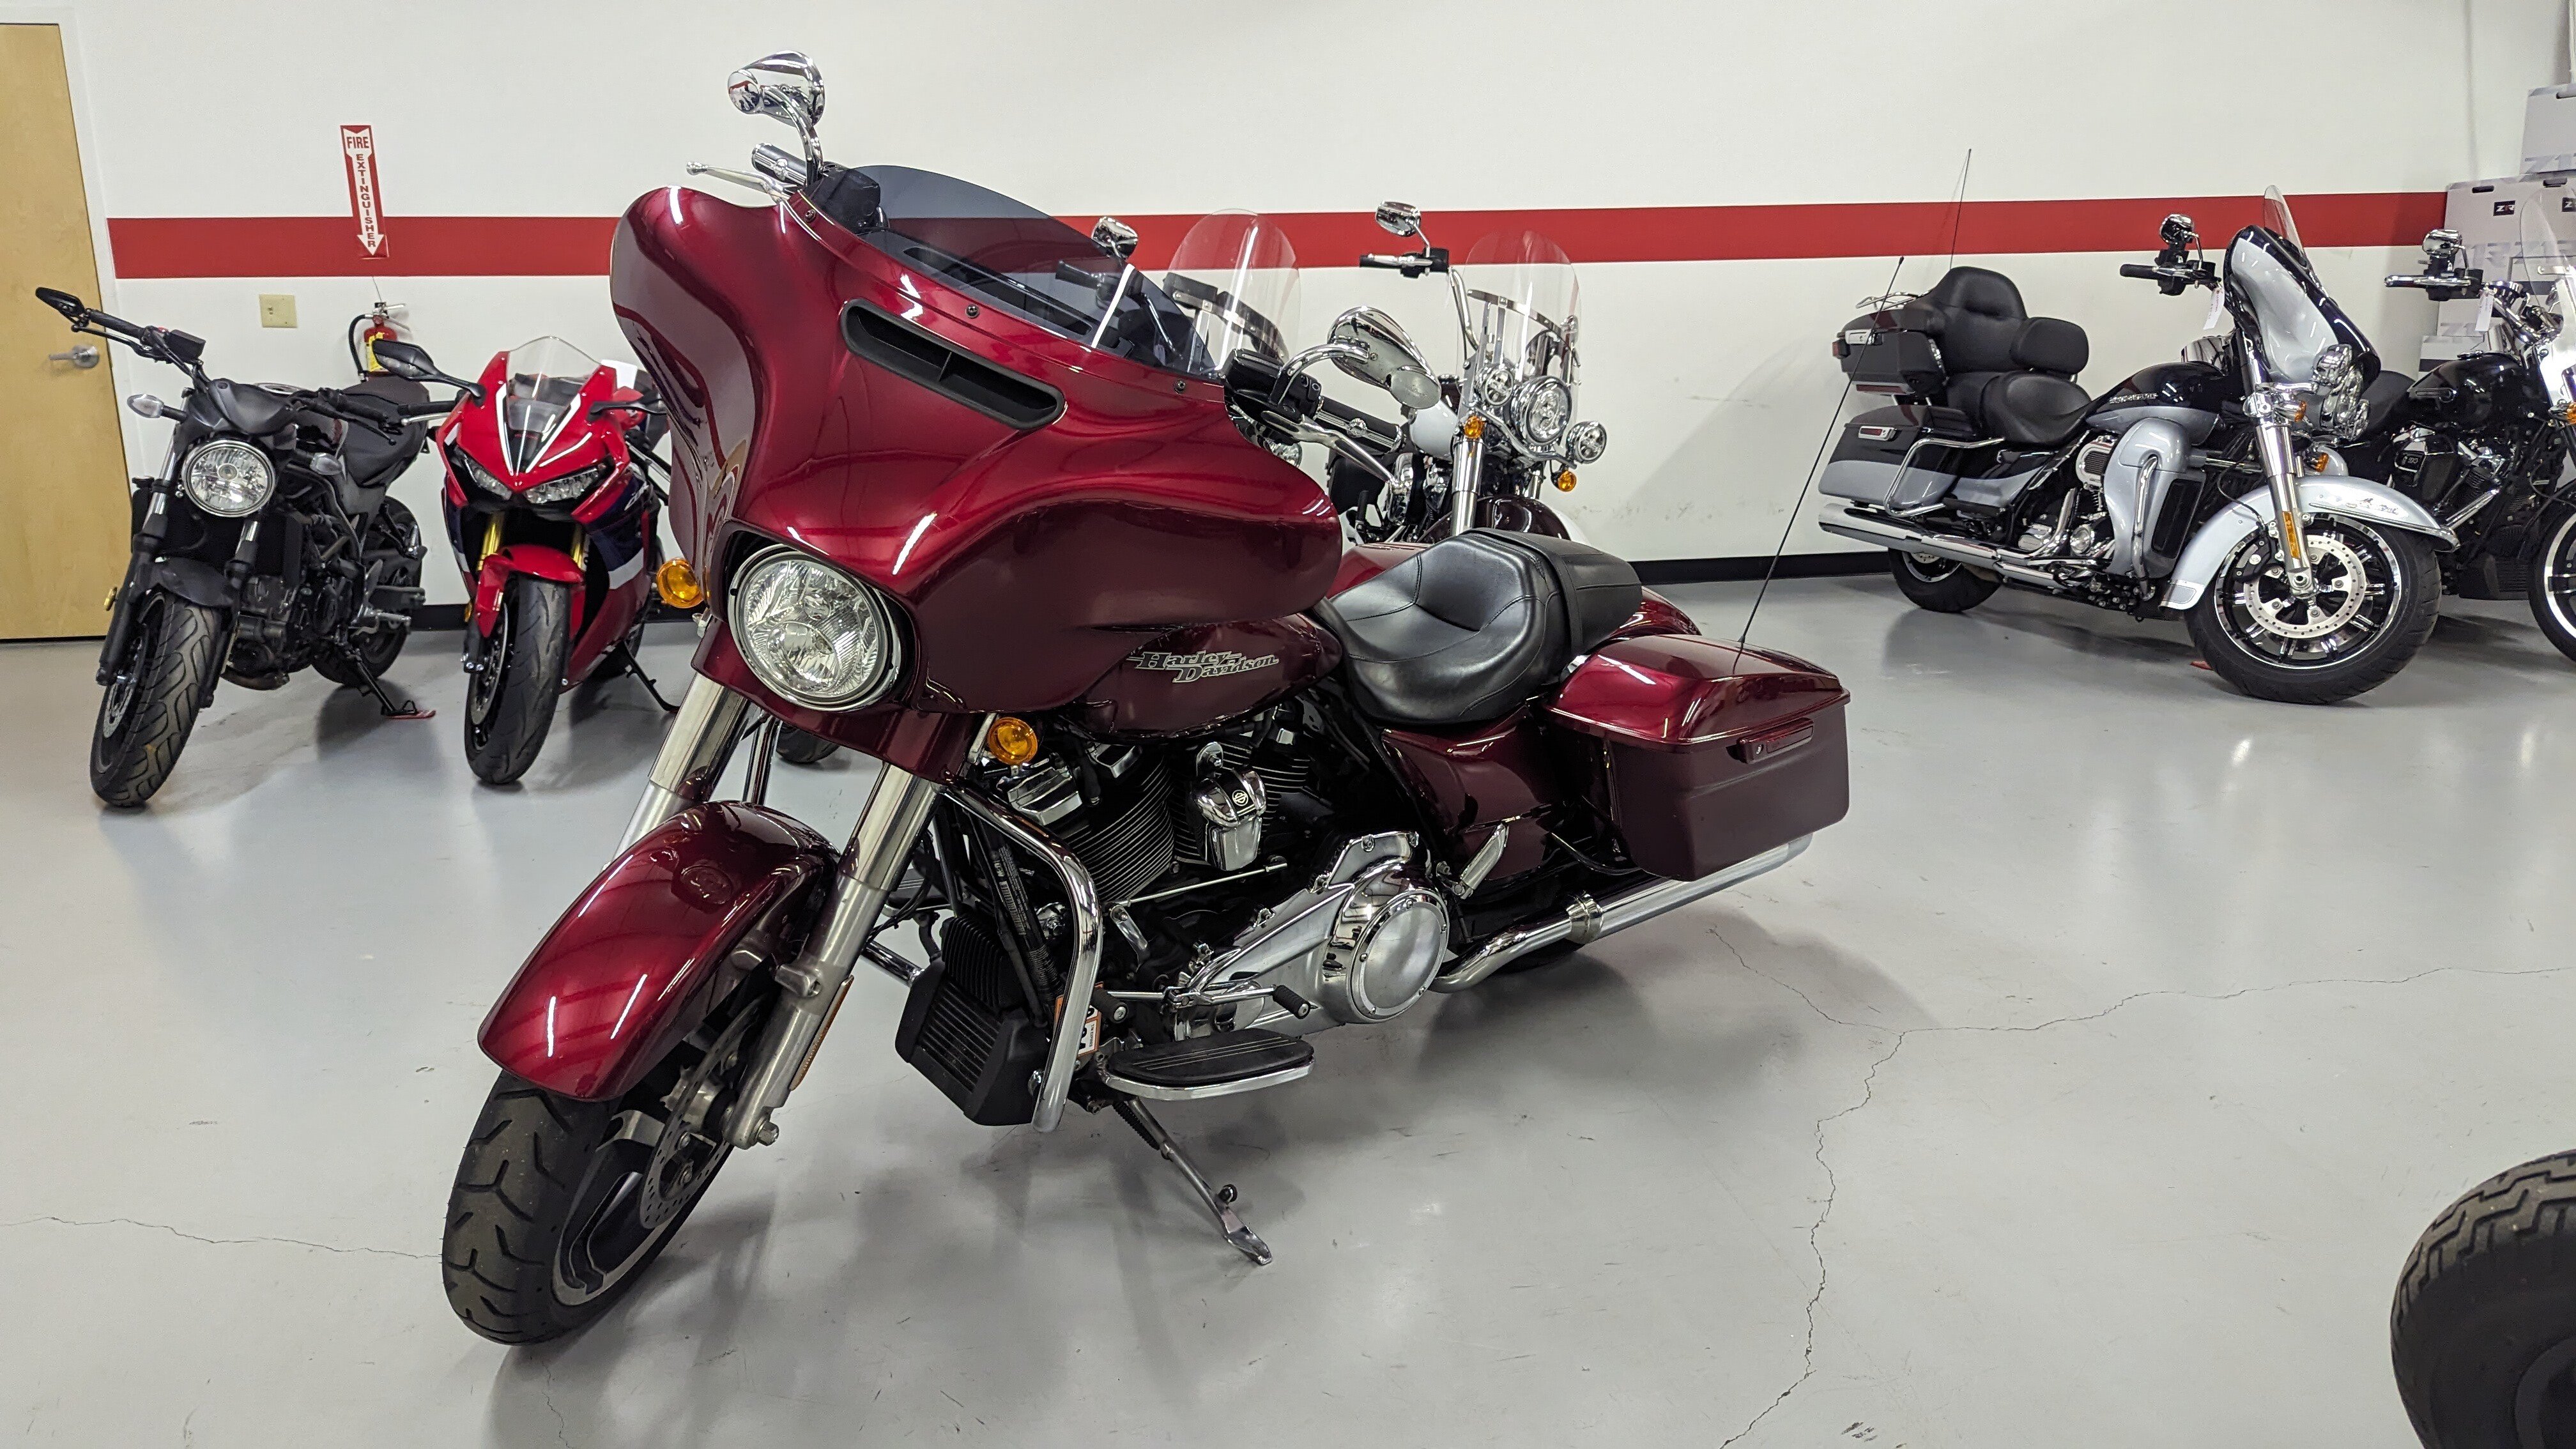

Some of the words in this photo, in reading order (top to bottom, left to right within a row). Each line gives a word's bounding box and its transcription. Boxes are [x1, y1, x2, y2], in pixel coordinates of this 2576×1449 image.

[346, 136, 370, 149] FIRE
[356, 154, 376, 247] EXTINGUISHER
[1172, 654, 1279, 683] Davidson
